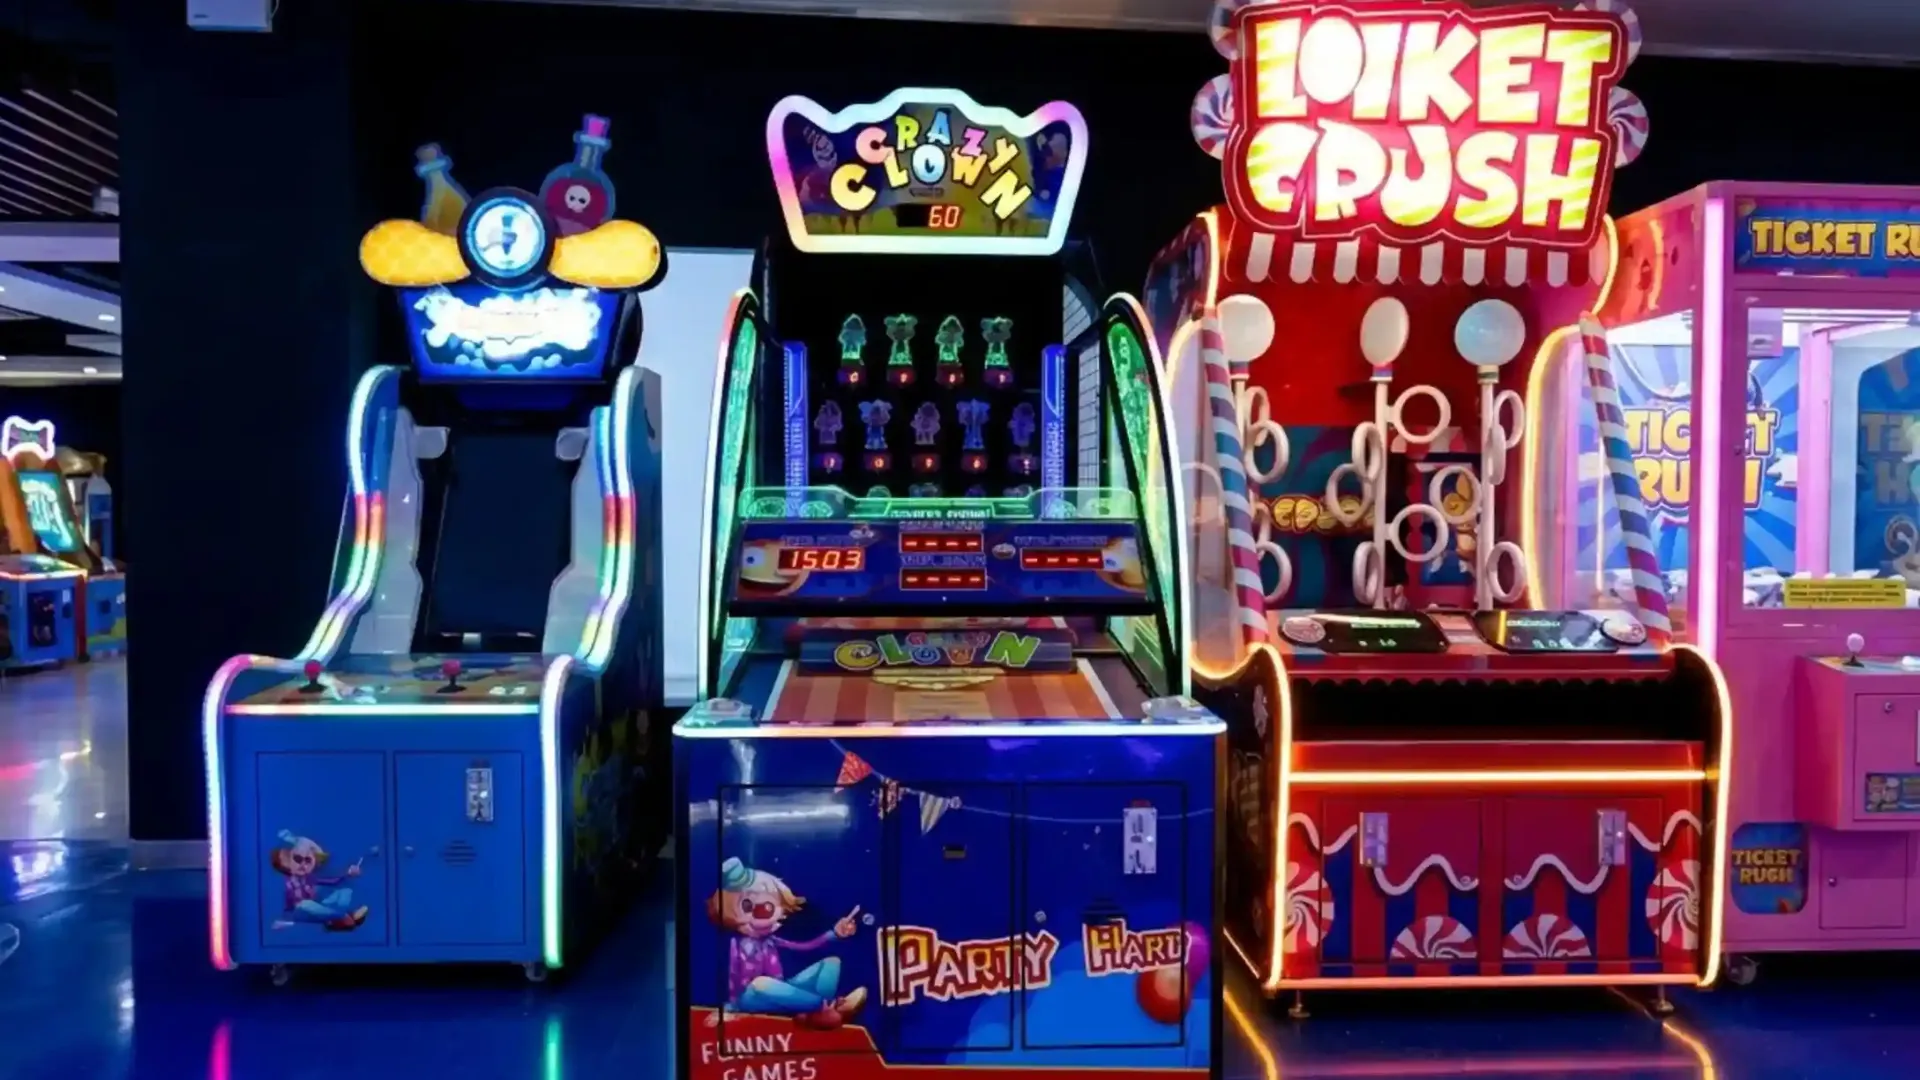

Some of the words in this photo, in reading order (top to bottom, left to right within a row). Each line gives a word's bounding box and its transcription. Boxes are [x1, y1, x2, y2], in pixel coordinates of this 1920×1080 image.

[855, 110, 1019, 174] CRAZY
[830, 143, 1032, 220] CLOWN
[1247, 118, 1601, 230] CRUSH
[929, 205, 960, 228] 60
[1752, 220, 1876, 256] TICKET
[1624, 410, 1776, 453] TICT
[791, 550, 861, 569] 1503
[880, 928, 1056, 1004] PARTY
[701, 1032, 792, 1064] FUNNY
